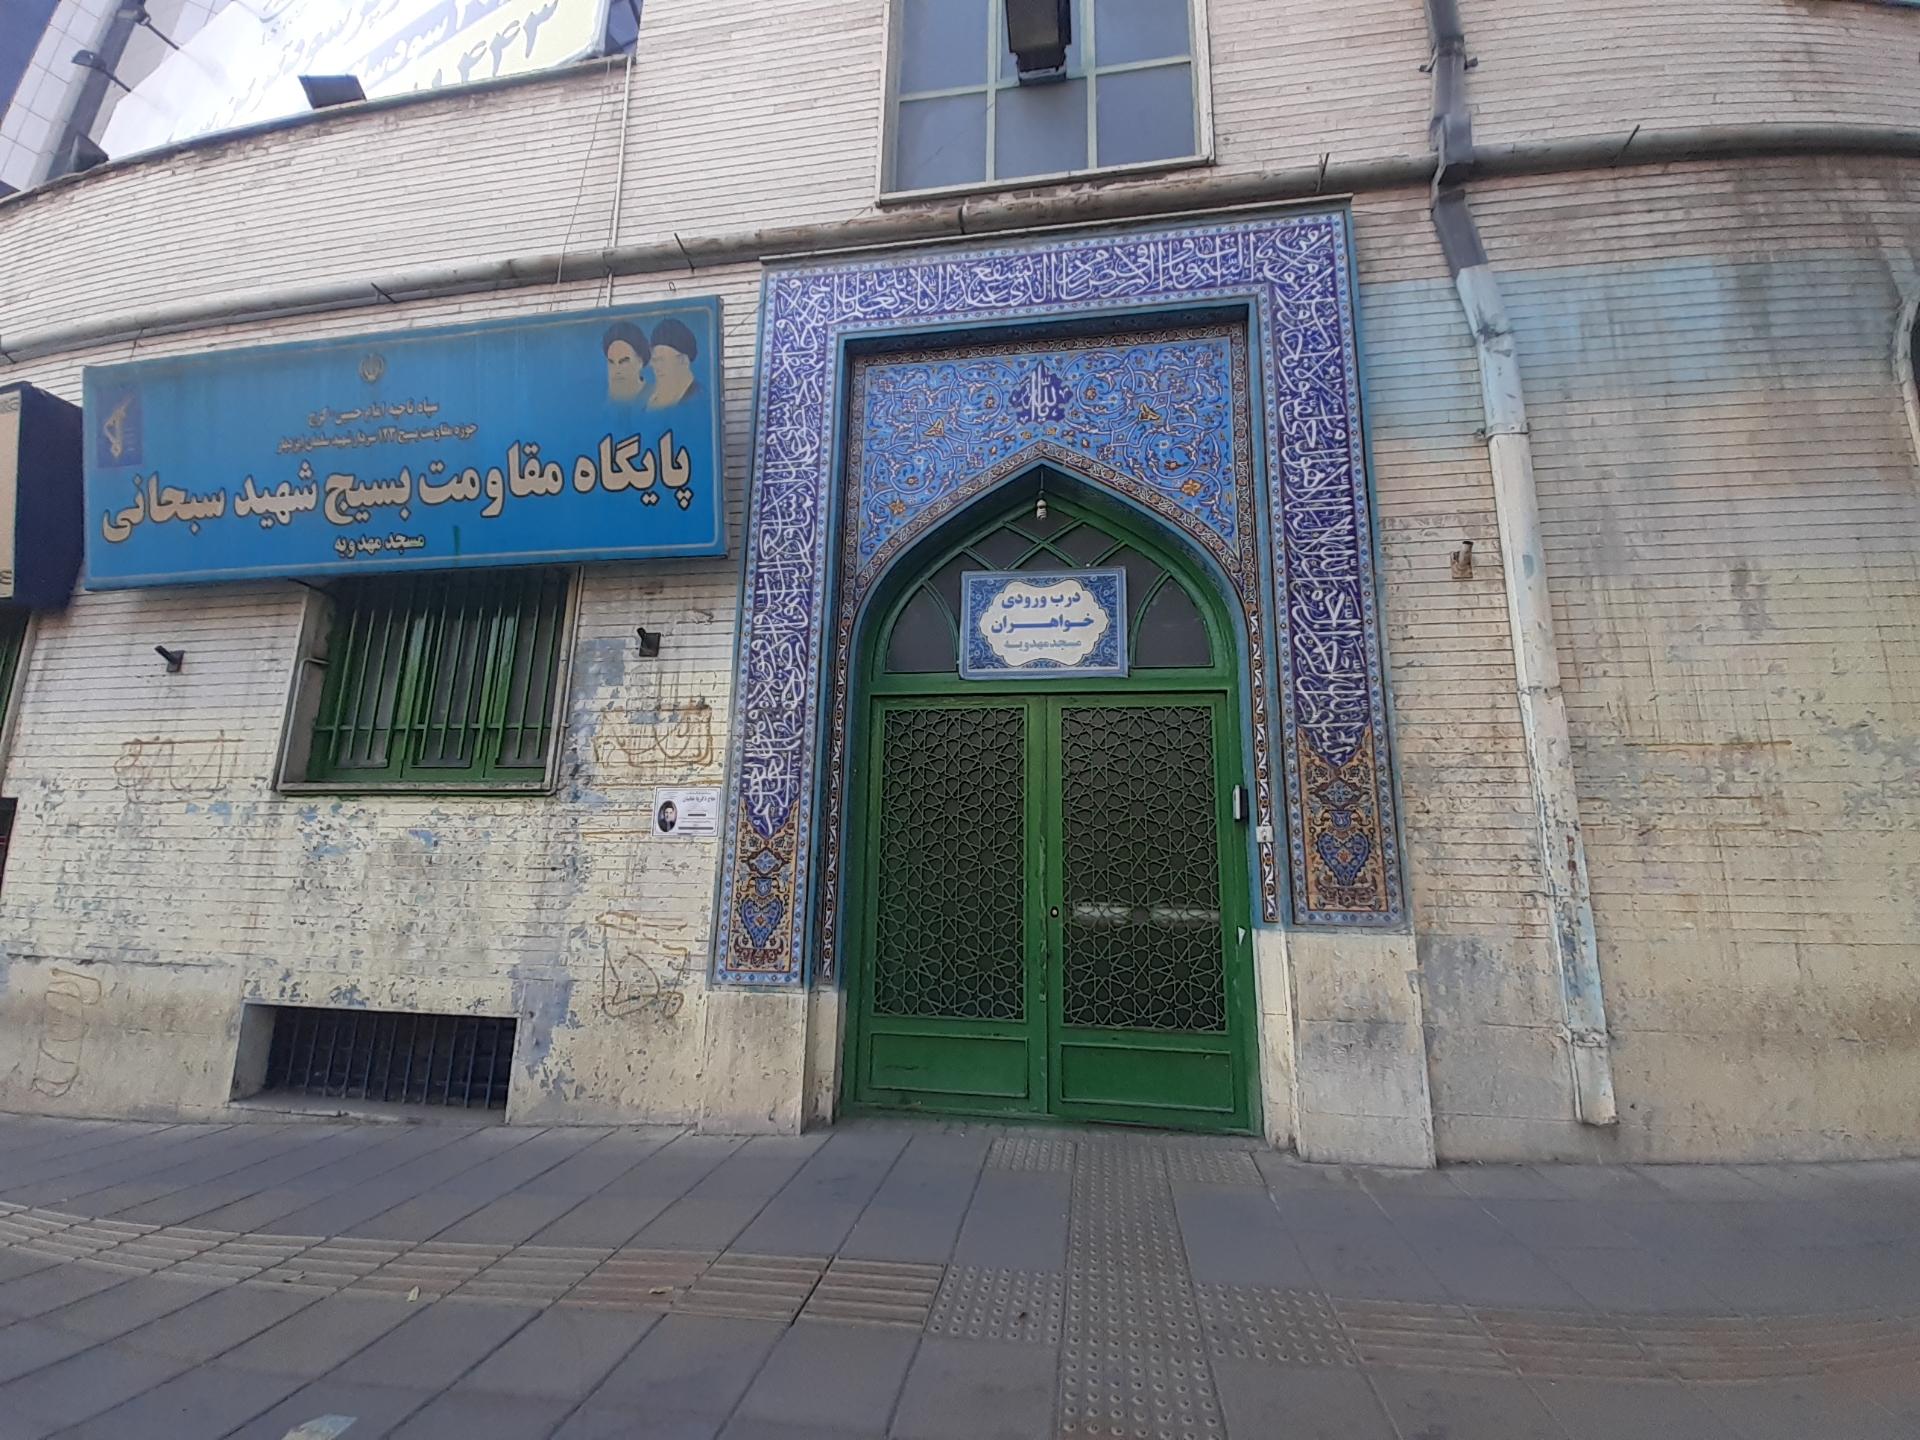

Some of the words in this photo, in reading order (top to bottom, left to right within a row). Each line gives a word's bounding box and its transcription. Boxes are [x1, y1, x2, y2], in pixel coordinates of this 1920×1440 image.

[417, 439, 565, 518] مقاومت
[572, 429, 695, 511] پایگاه
[101, 470, 226, 543] سبحانی
[233, 458, 319, 530] شهید
[324, 465, 412, 525] بسیج
[332, 534, 384, 560] مهدویه
[384, 532, 427, 557] مسجد
[1001, 592, 1048, 609] ورودی
[1050, 591, 1082, 608] درب
[990, 613, 1095, 634] خواهران
[1003, 638, 1053, 652] مهدویه
[1051, 638, 1082, 651] مسجد
